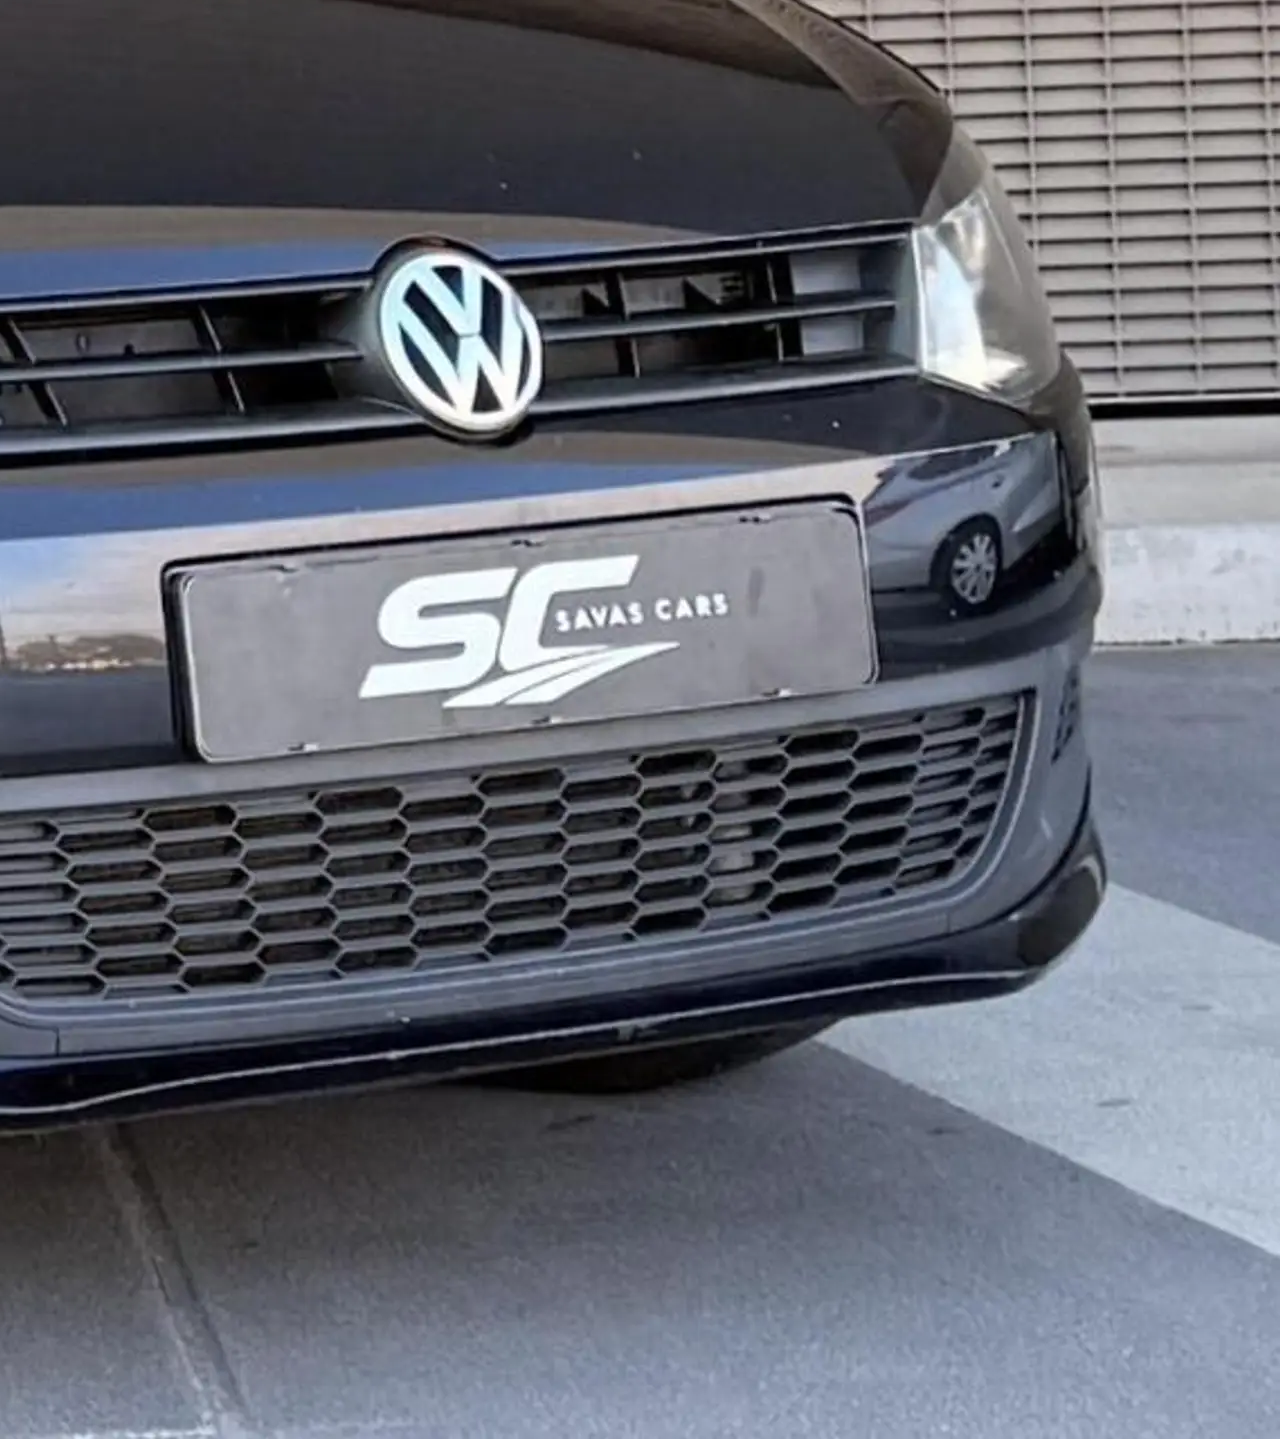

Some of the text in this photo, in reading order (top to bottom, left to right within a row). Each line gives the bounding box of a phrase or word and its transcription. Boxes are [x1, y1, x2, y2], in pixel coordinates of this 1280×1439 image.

[358, 555, 638, 700] SC
[554, 592, 729, 633] SAVAS CARS
